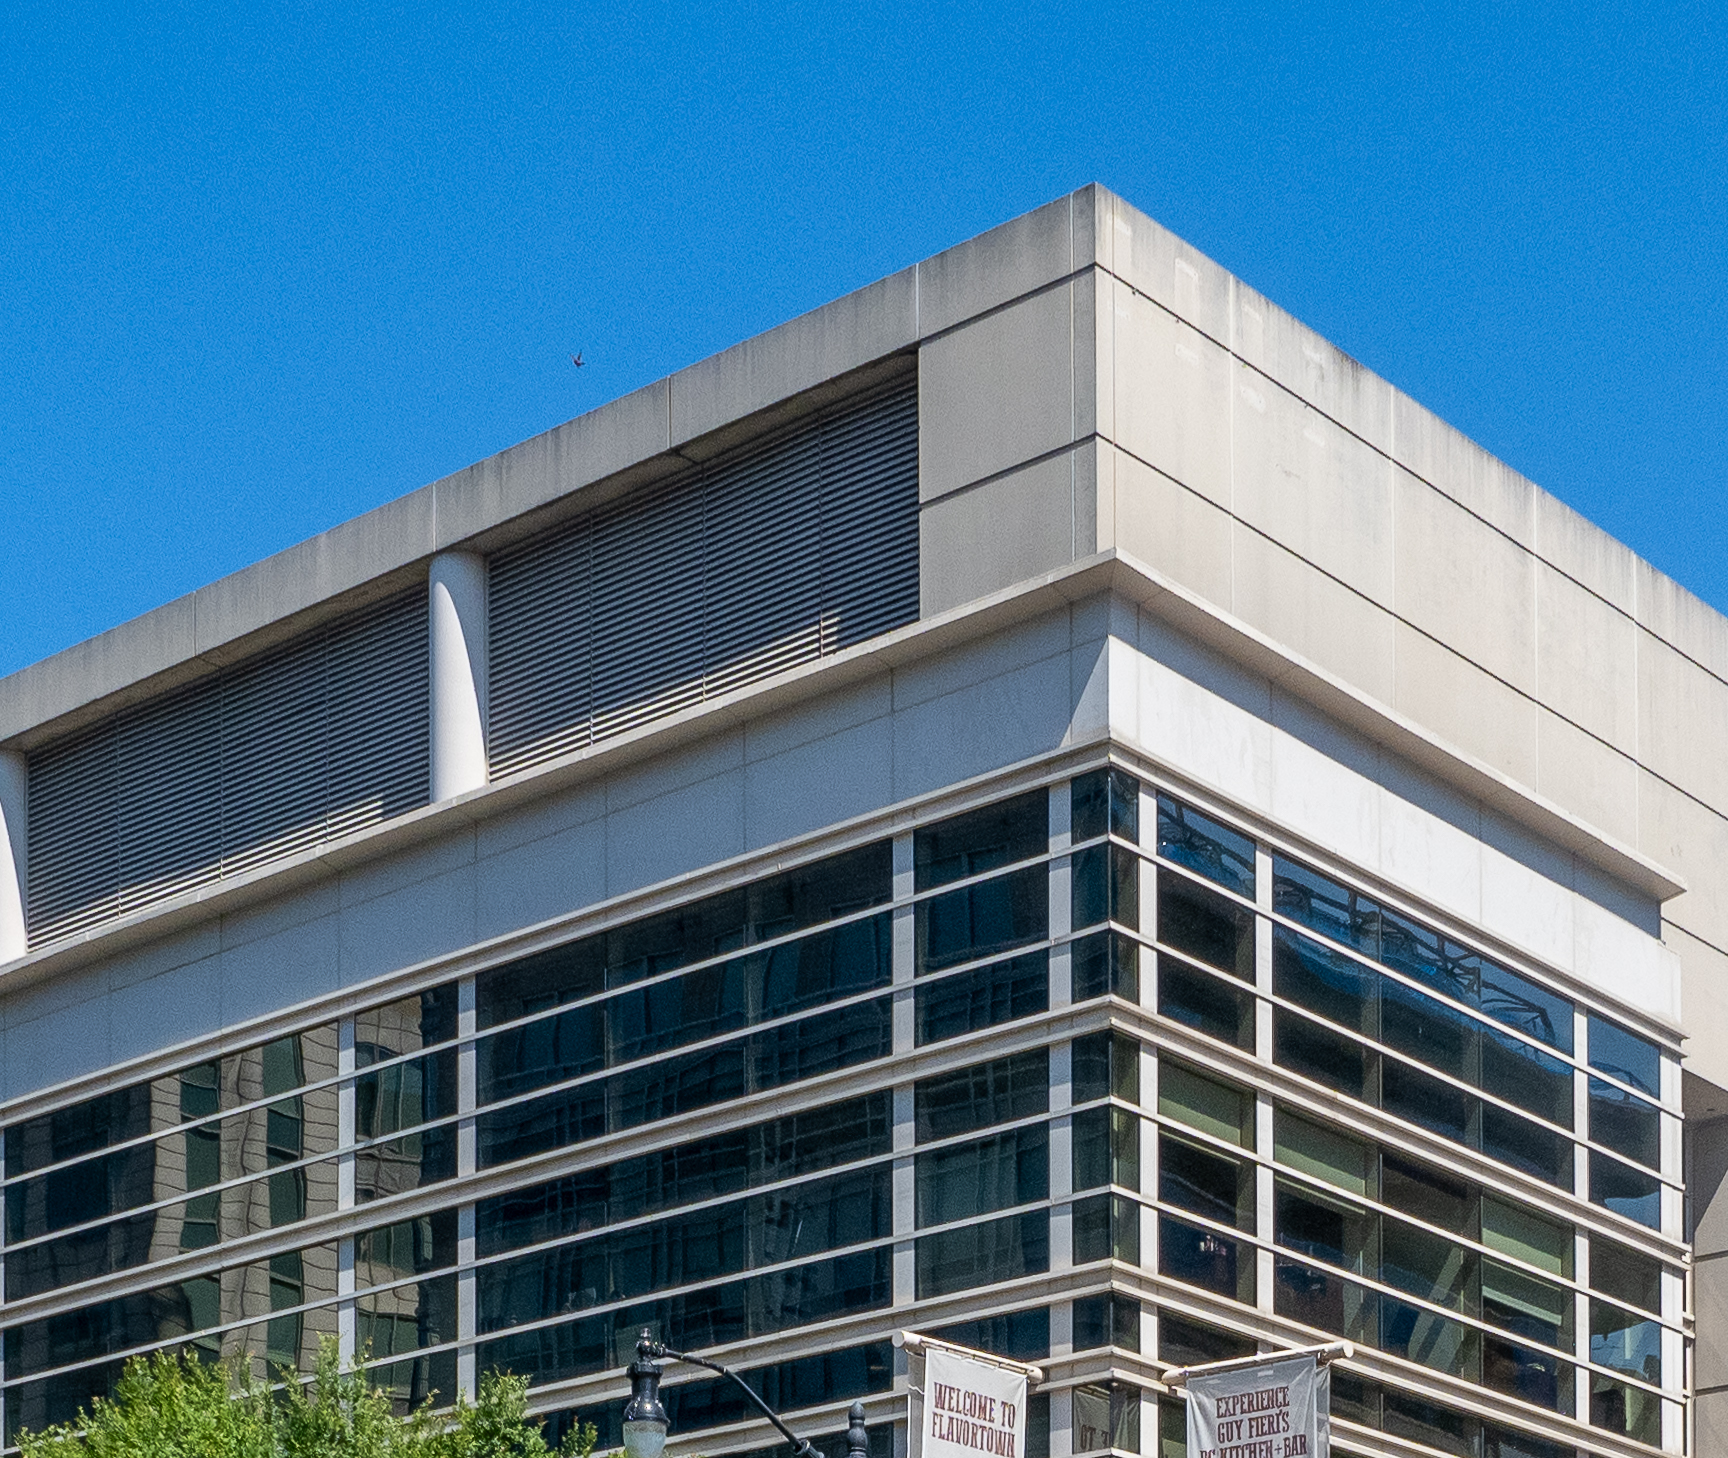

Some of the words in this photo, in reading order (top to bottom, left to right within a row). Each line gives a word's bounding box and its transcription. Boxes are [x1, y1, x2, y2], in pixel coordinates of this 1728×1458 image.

[934, 1381, 996, 1423] WELCOME
[1001, 1401, 1016, 1429] TO
[1216, 1385, 1290, 1418] EXPERIENCE
[932, 1411, 1016, 1458] FLAVORTOWN
[1217, 1419, 1244, 1444] GUY
[1248, 1409, 1290, 1439] FIERI'S
[1283, 1434, 1308, 1458] BAR
